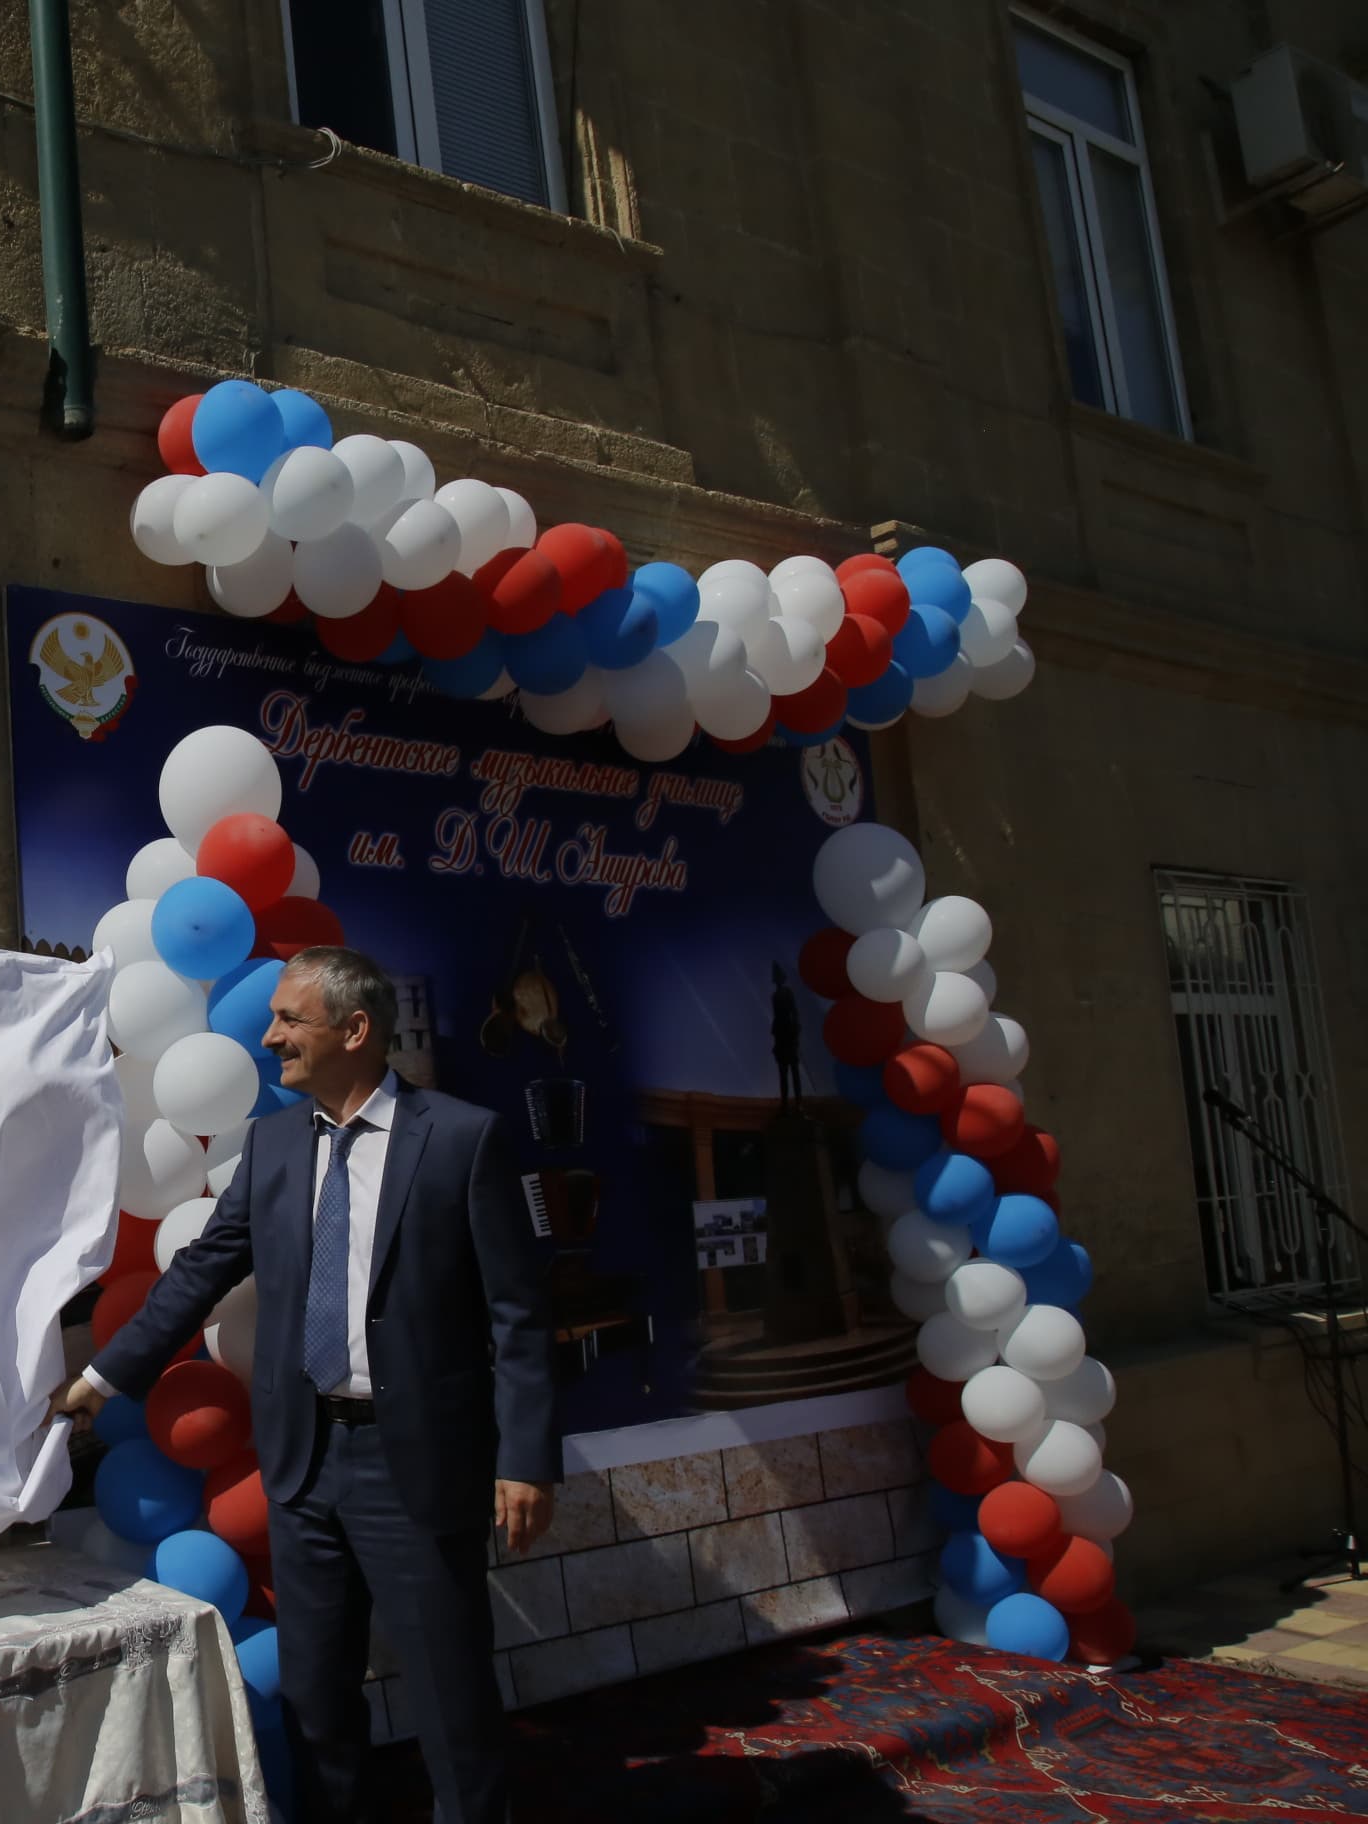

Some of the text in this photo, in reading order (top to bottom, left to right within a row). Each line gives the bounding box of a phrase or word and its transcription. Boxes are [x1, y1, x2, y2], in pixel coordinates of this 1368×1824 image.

[165, 624, 296, 679] Государственное
[259, 690, 460, 791] Дербентское
[470, 747, 640, 815] музыкальное
[635, 775, 744, 831] училище
[347, 831, 406, 869] им.
